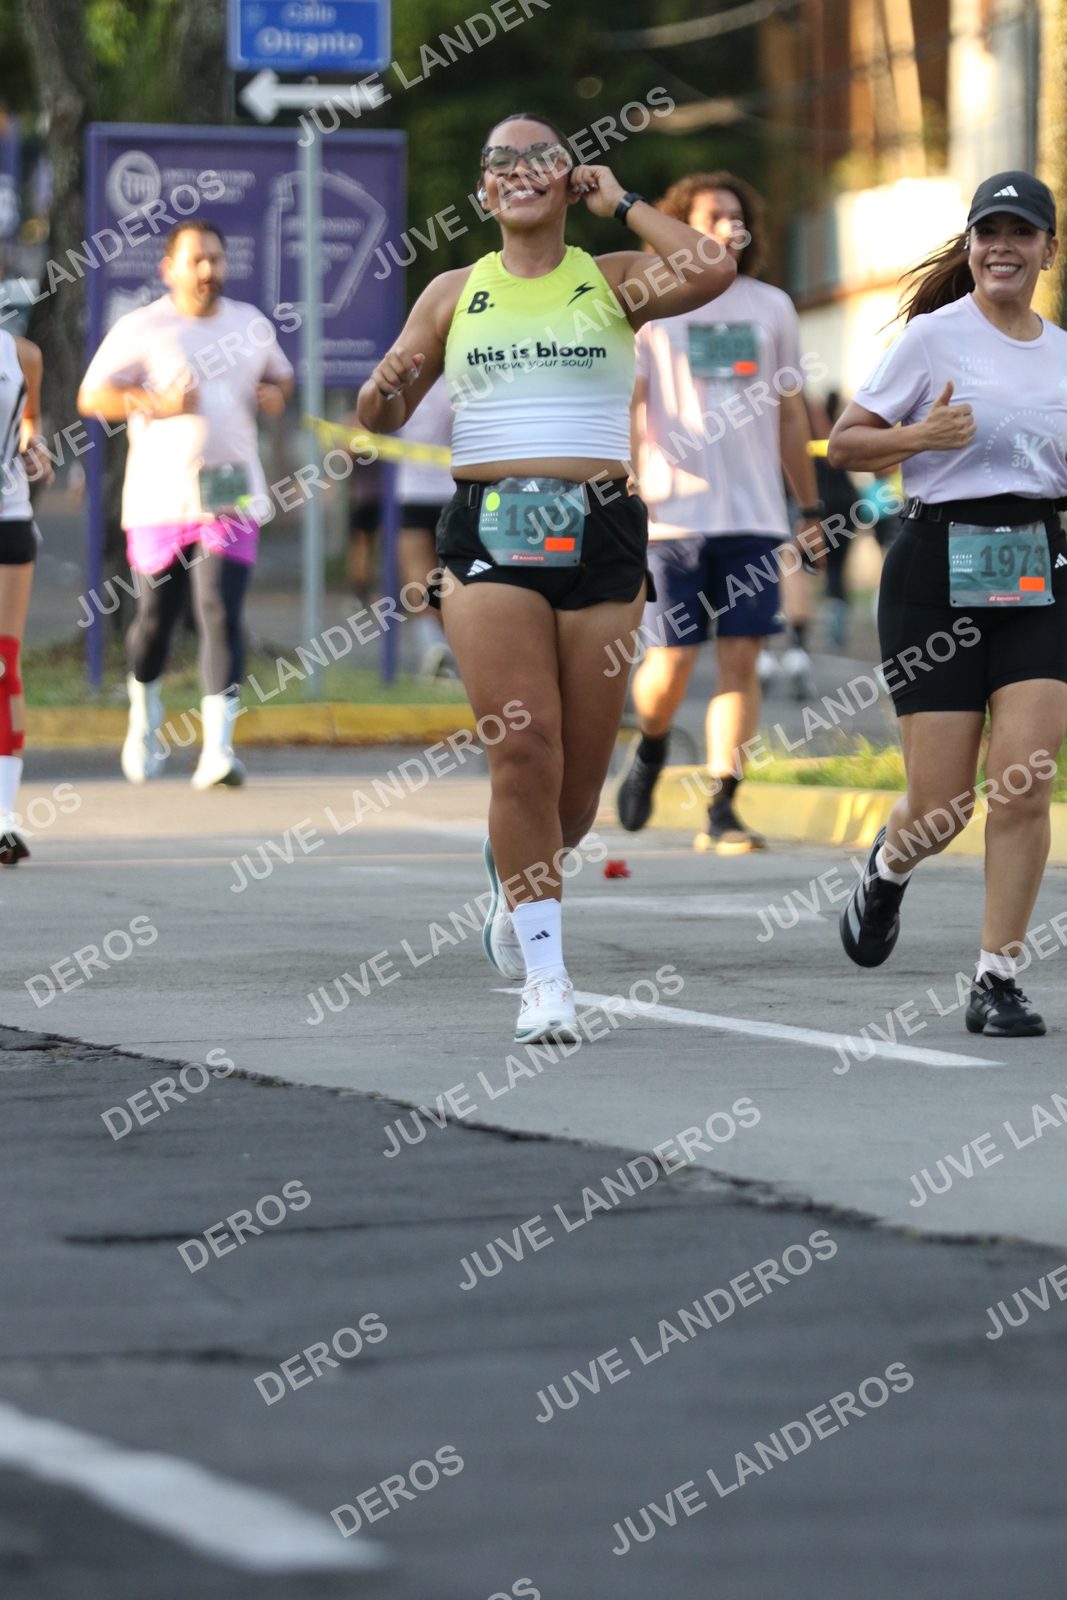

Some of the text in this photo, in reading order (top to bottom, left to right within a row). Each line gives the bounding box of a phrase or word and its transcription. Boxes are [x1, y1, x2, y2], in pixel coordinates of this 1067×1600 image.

[467, 341, 607, 366] this is bloom
[980, 544, 1047, 577] 1973
